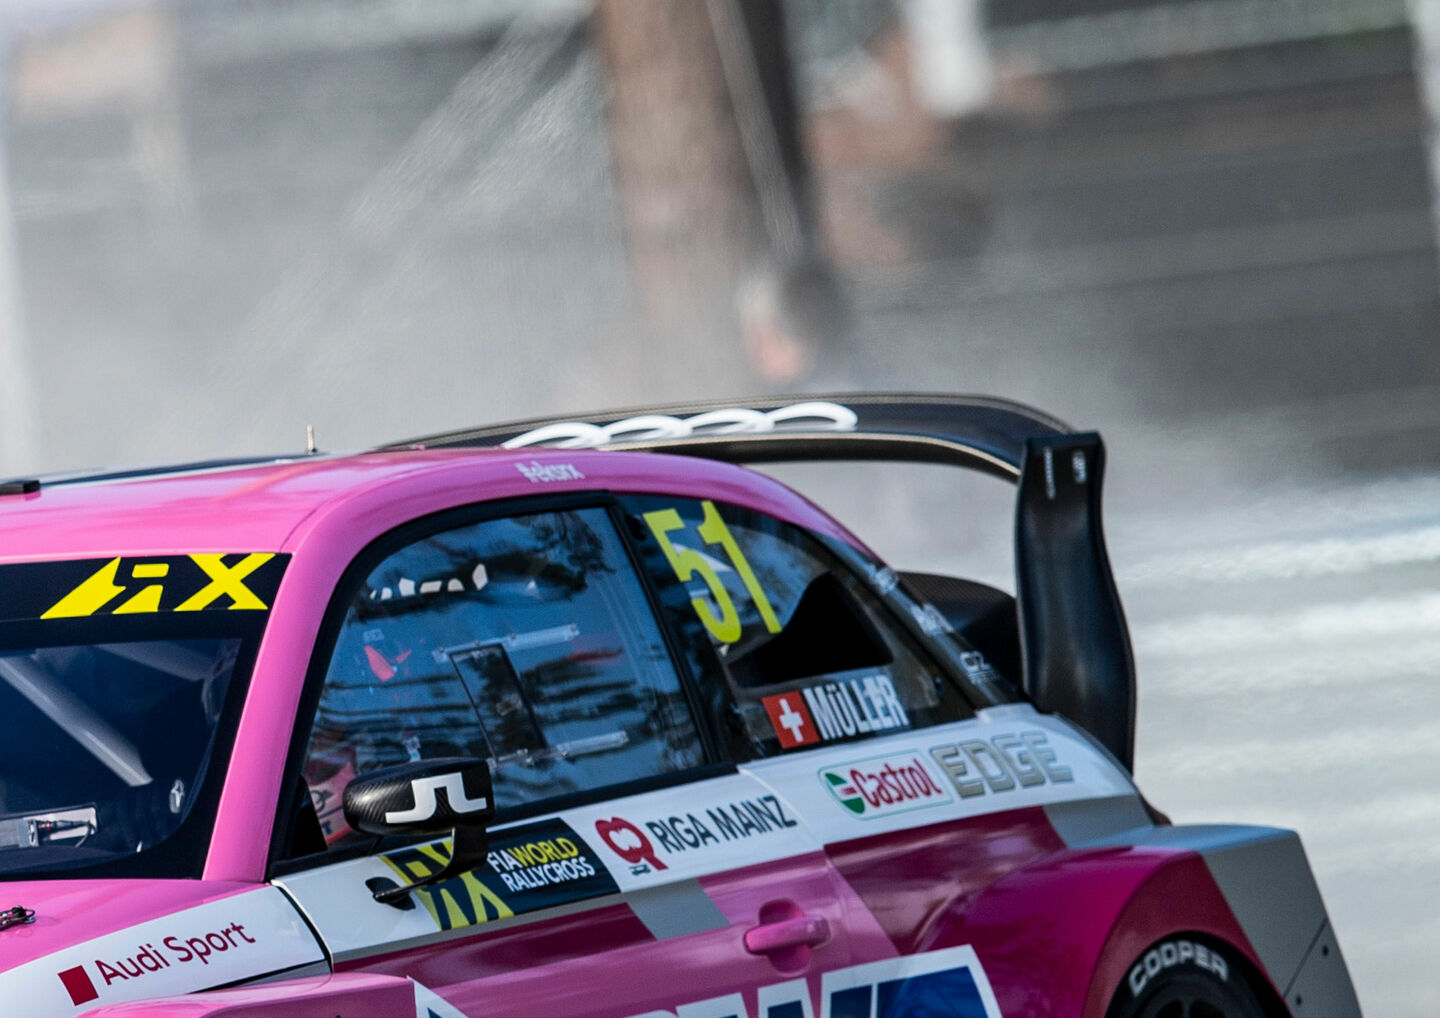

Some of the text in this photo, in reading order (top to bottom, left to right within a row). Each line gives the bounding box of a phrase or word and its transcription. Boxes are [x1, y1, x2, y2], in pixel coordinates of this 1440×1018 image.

[643, 501, 781, 643] 51
[803, 674, 909, 740] MÜLLER
[849, 730, 1074, 808] Castrol EDGE
[645, 794, 798, 854] RIGA MAINZ
[500, 856, 596, 893] RALLYCROSS
[94, 922, 256, 986] Audi Sport
[1128, 939, 1229, 997] COOPER
